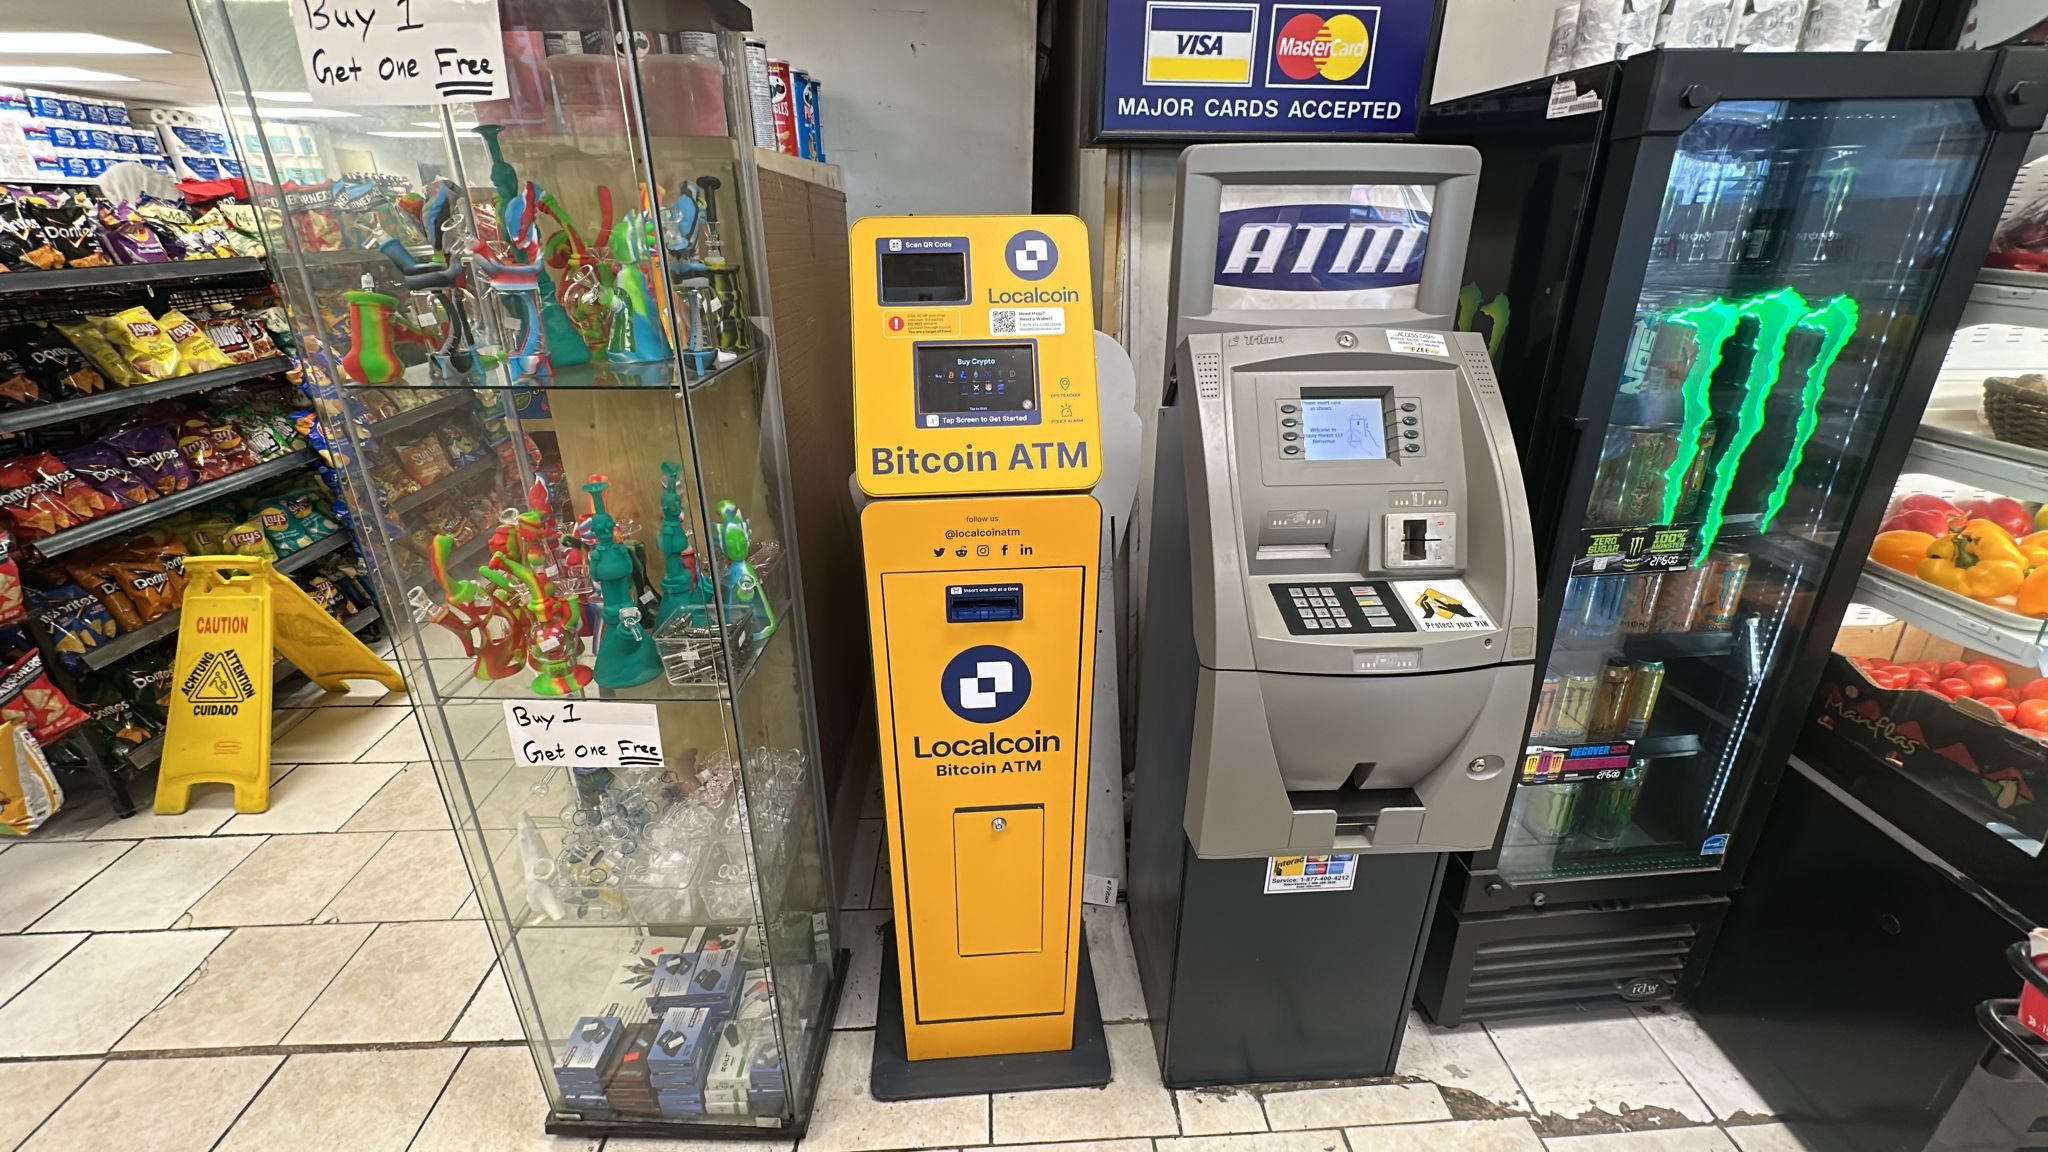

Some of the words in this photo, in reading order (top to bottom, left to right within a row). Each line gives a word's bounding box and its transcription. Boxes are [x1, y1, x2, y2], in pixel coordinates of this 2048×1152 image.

[304, 0, 375, 42] Buy
[397, 0, 424, 32] 1
[1176, 34, 1223, 56] VISA
[1278, 36, 1366, 58] MasterCard
[312, 48, 362, 86] Get
[434, 47, 494, 76] Free
[1118, 97, 1194, 117] MAJOR
[1204, 98, 1279, 118] CARDS
[1288, 100, 1401, 120] ACCEPTED
[905, 241, 921, 249] Scan
[923, 241, 933, 249] QR
[1221, 222, 1421, 274] ATM
[988, 286, 1079, 304] Localcoin
[957, 358, 970, 366] Buy
[972, 358, 995, 366] Crypto
[956, 416, 981, 424] Screen
[127, 448, 180, 468] Doritos
[871, 443, 997, 475] Bitcoin
[1008, 442, 1088, 470] ATM
[945, 528, 1020, 540] @localcoinatm
[1592, 537, 1618, 546] ZERO
[1654, 533, 1687, 543] 100%
[1587, 544, 1620, 554] SUGAR
[1651, 542, 1686, 550] MONSTER
[196, 617, 248, 634] CAUTION
[1425, 621, 1455, 629] Protect
[1455, 621, 1472, 629] your
[181, 651, 215, 696] ACHTUNG
[224, 649, 256, 698] ATTENTION
[193, 705, 238, 715] CUIDADO
[512, 705, 555, 731] Buy
[562, 703, 582, 723] 1
[523, 740, 566, 764] Get
[617, 740, 659, 756] Free
[914, 730, 1060, 758] Localcoin
[1570, 745, 1611, 757] RECOVER
[936, 762, 996, 776] Bitcoin
[1001, 760, 1041, 774] ATM
